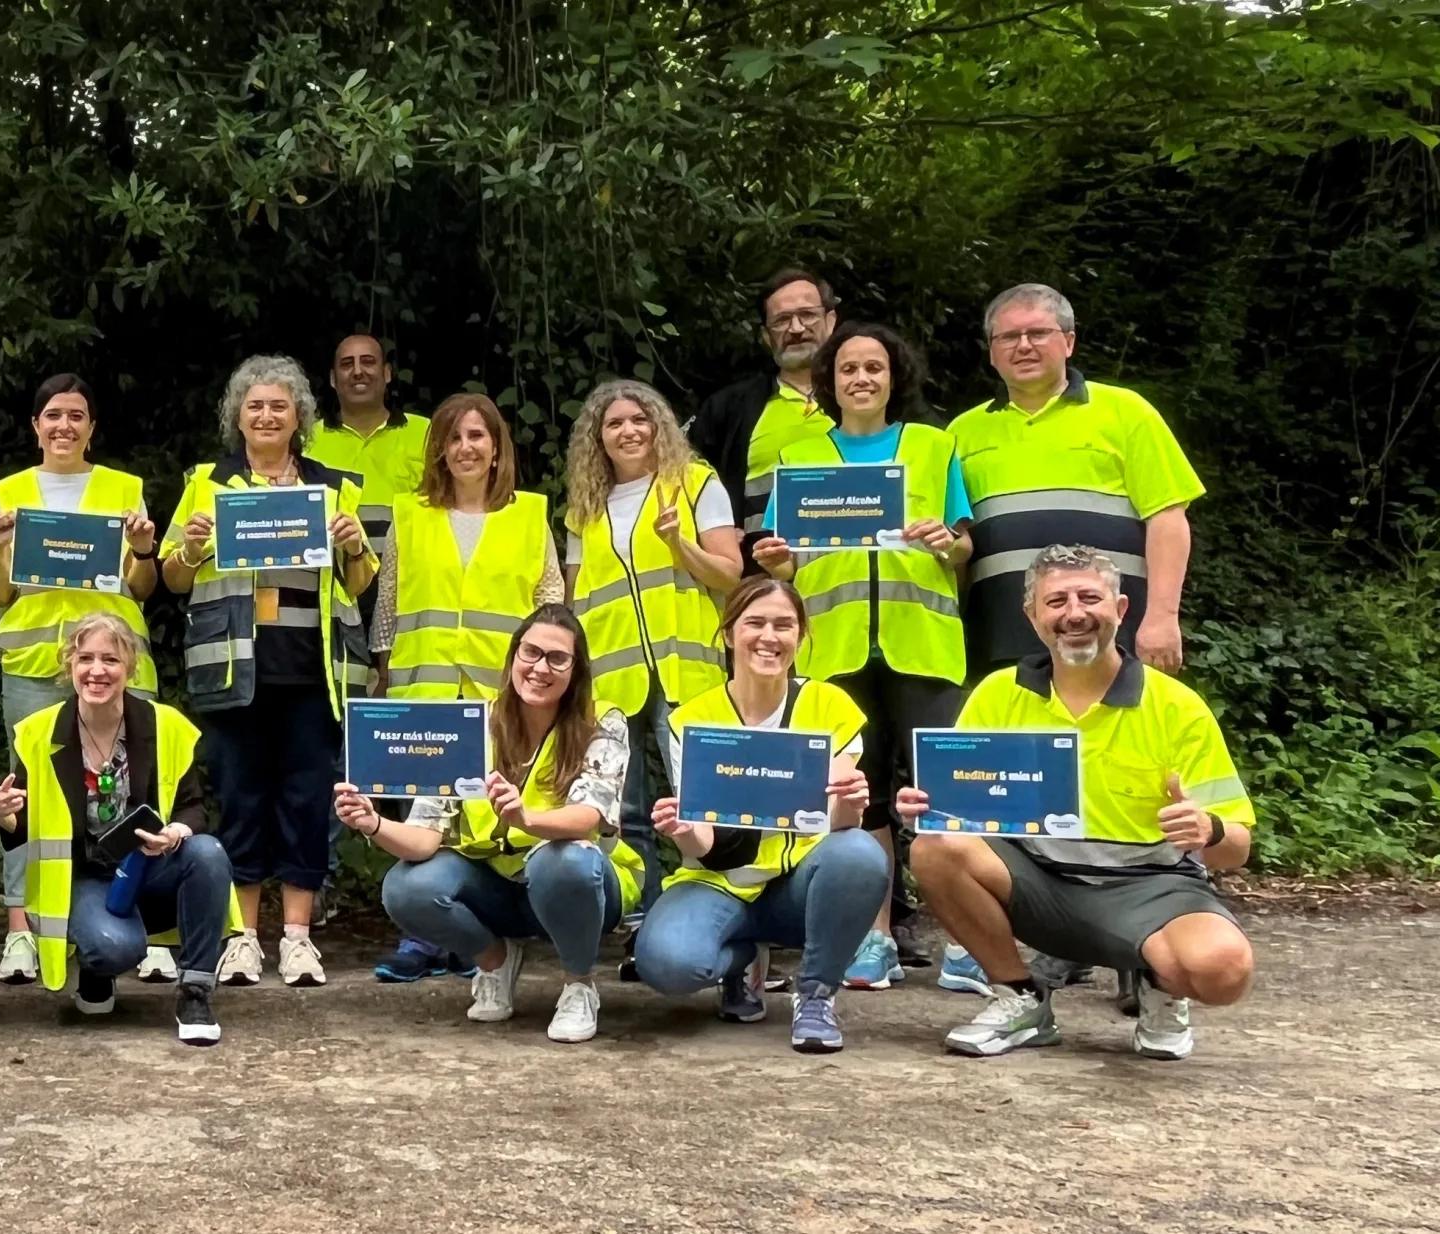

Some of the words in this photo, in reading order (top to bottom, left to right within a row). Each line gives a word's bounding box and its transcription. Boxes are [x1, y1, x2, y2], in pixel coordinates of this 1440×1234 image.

[800, 497, 844, 506] Consumir
[845, 496, 881, 505] Alcohol
[798, 508, 884, 518] Responsablemente
[235, 520, 273, 528] Alimentar
[236, 532, 246, 540] de
[90, 544, 94, 552] y
[373, 730, 400, 740] Pasar
[402, 731, 422, 740] más
[424, 731, 458, 743] tiempo
[388, 746, 406, 754] con
[408, 744, 444, 756] Amigos
[716, 764, 744, 776] Dejar
[746, 766, 759, 776] de
[761, 768, 794, 779] Fumar
[953, 770, 996, 780] Meditar
[1000, 772, 1006, 780] 5
[1008, 771, 1030, 782] min
[1032, 770, 1043, 782] al
[988, 786, 1008, 796] día
